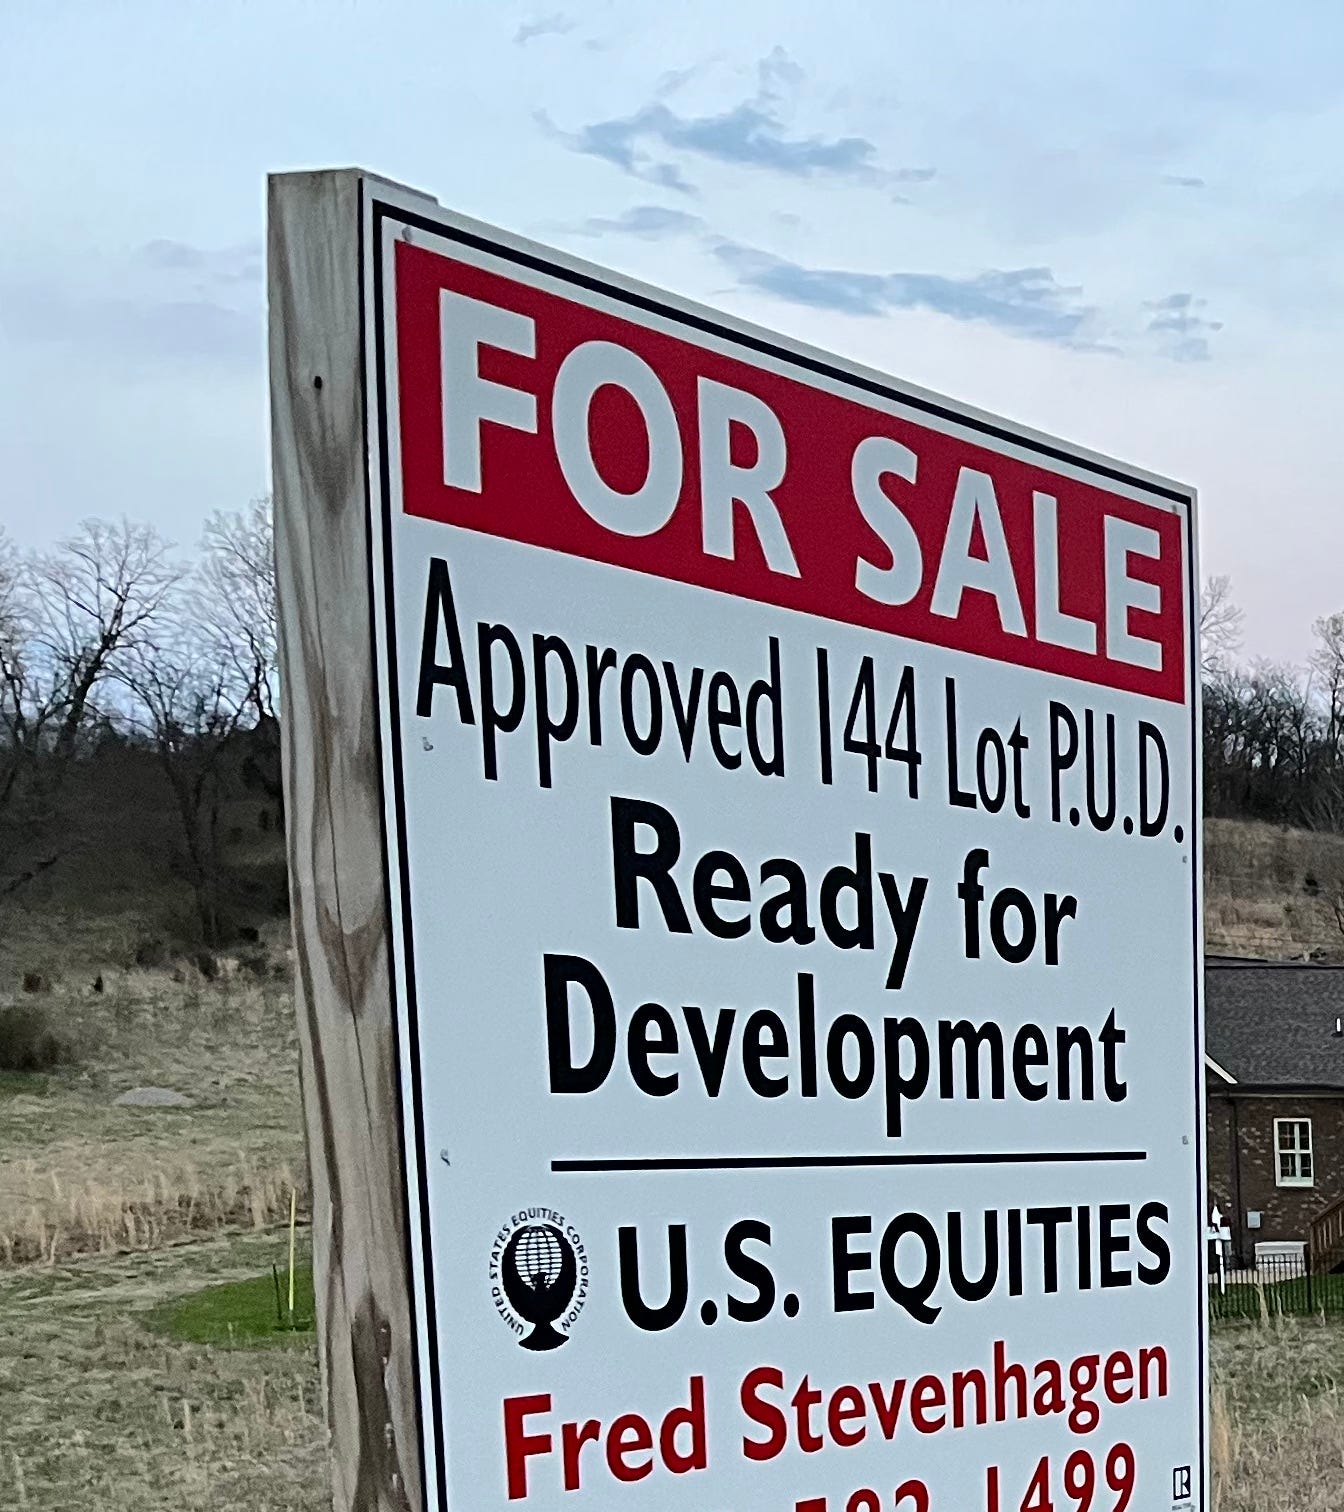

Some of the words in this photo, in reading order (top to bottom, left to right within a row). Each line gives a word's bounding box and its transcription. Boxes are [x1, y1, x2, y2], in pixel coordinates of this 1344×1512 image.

[438, 287, 802, 579] FOR
[850, 435, 1164, 672] SALE
[416, 556, 786, 789] Approved
[815, 647, 922, 801] 144
[944, 676, 1031, 822] Lot
[1050, 701, 1185, 845] P.U.D.
[609, 795, 929, 991] Ready
[957, 847, 1078, 966] for
[542, 952, 1129, 1138] Development
[488, 1223, 512, 1280] STATES
[511, 1206, 566, 1227] EQUITIES
[560, 1225, 589, 1332] CORPORATION
[617, 1218, 800, 1333] U.S.
[831, 1201, 1172, 1325] EQUITIES
[490, 1286, 525, 1336] UNITED
[502, 1375, 708, 1501] Fred
[740, 1340, 1170, 1462] Stevenhagen
